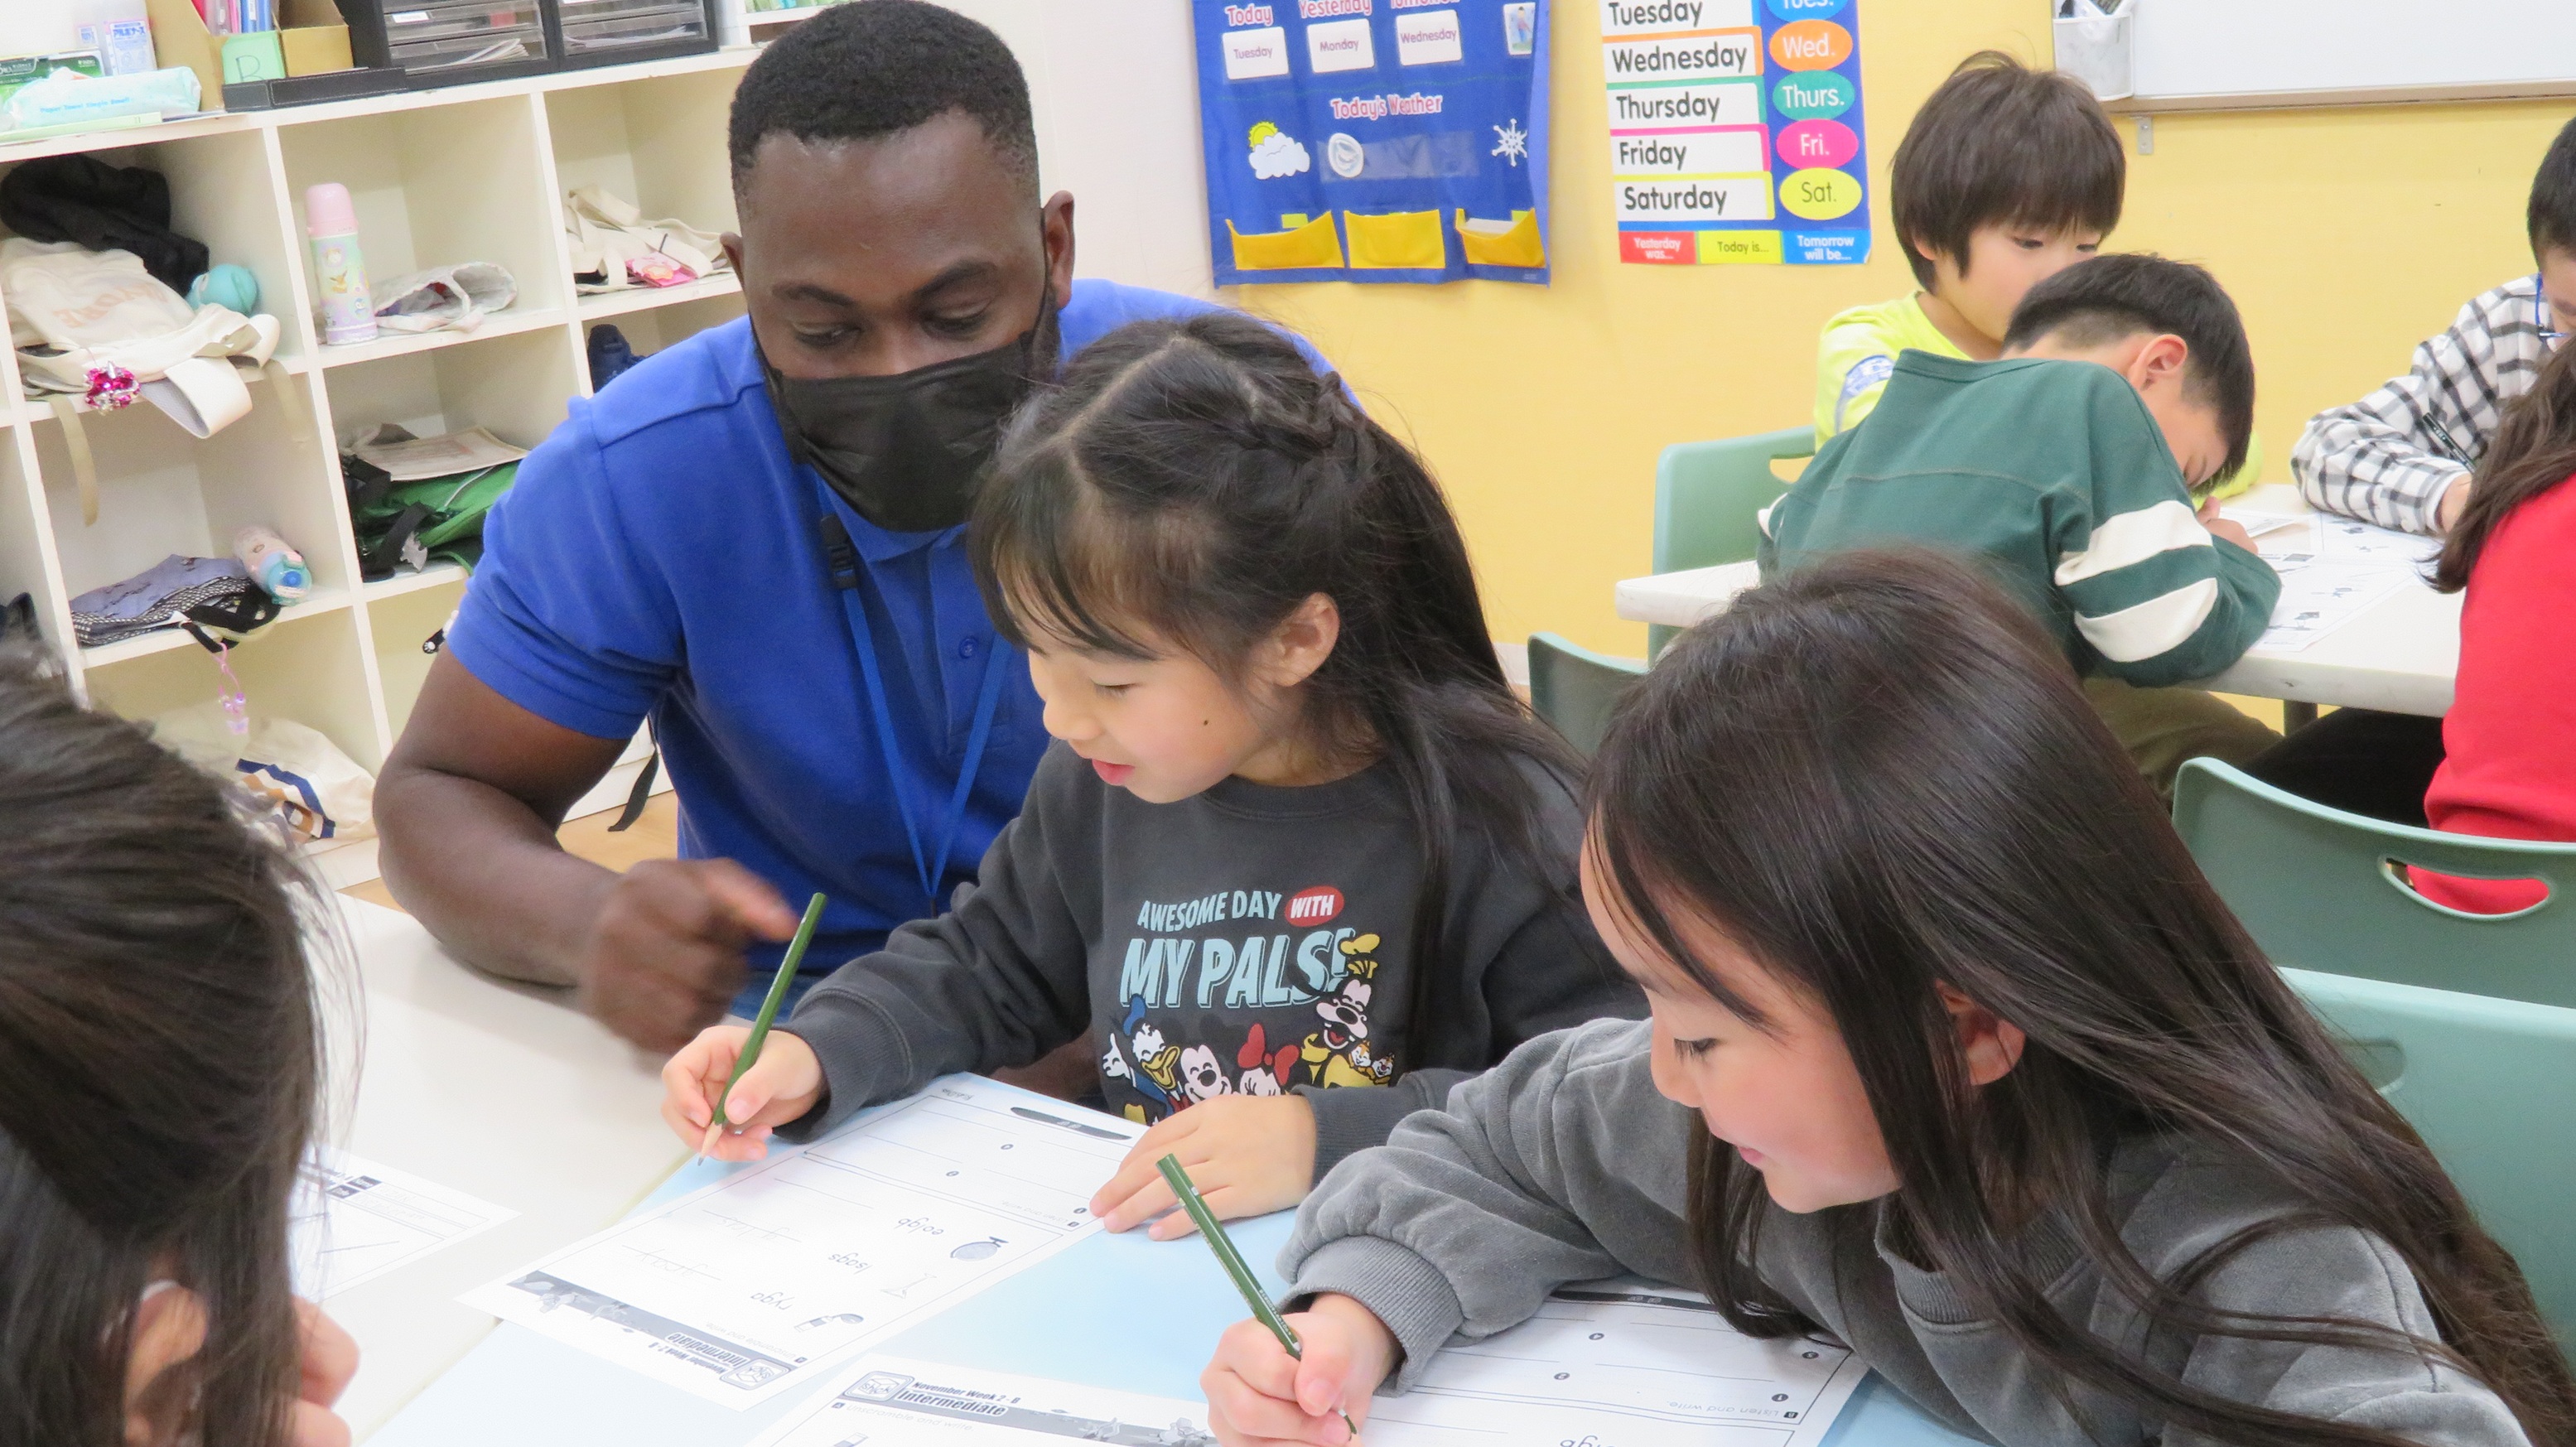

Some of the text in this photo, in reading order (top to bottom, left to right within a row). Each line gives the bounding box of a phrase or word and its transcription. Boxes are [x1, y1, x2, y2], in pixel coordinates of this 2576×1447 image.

[1227, 6, 1273, 25] Today
[1609, 0, 1703, 27] Tuesday
[1319, 40, 1359, 52] Monday
[1401, 28, 1457, 44] Wednesday
[1782, 36, 1836, 58] Wed.
[1234, 46, 1273, 60] Tuesday
[1612, 41, 1747, 73] Wednesday
[1331, 94, 1443, 119] Today's Weather
[1616, 91, 1720, 123] Thursday
[1782, 84, 1845, 108] Thurs.
[1618, 140, 1687, 171] Friday
[1800, 133, 1830, 156] Fri.
[1623, 184, 1727, 215] Saturday
[1801, 181, 1837, 204] Sat.
[1633, 237, 1681, 252] Yesterday
[1717, 240, 1749, 254] Today
[1797, 235, 1855, 247] Tomorrow
[1805, 248, 1824, 260] will
[1136, 890, 1335, 932] AWESOME DAY WITH
[1119, 938, 1195, 1009] MY
[894, 1217, 944, 1236] eolgb
[827, 1252, 874, 1275] lsags
[750, 1291, 795, 1310] ryga
[668, 1333, 745, 1367] Intermediate
[912, 1381, 966, 1396] November
[967, 1389, 997, 1401] Week
[897, 1390, 1008, 1416] Intermediate
[1667, 1401, 1702, 1411] write.
[1739, 1407, 1779, 1417] Listen
[847, 1404, 914, 1421] Unscramble
[917, 1417, 942, 1426] and
